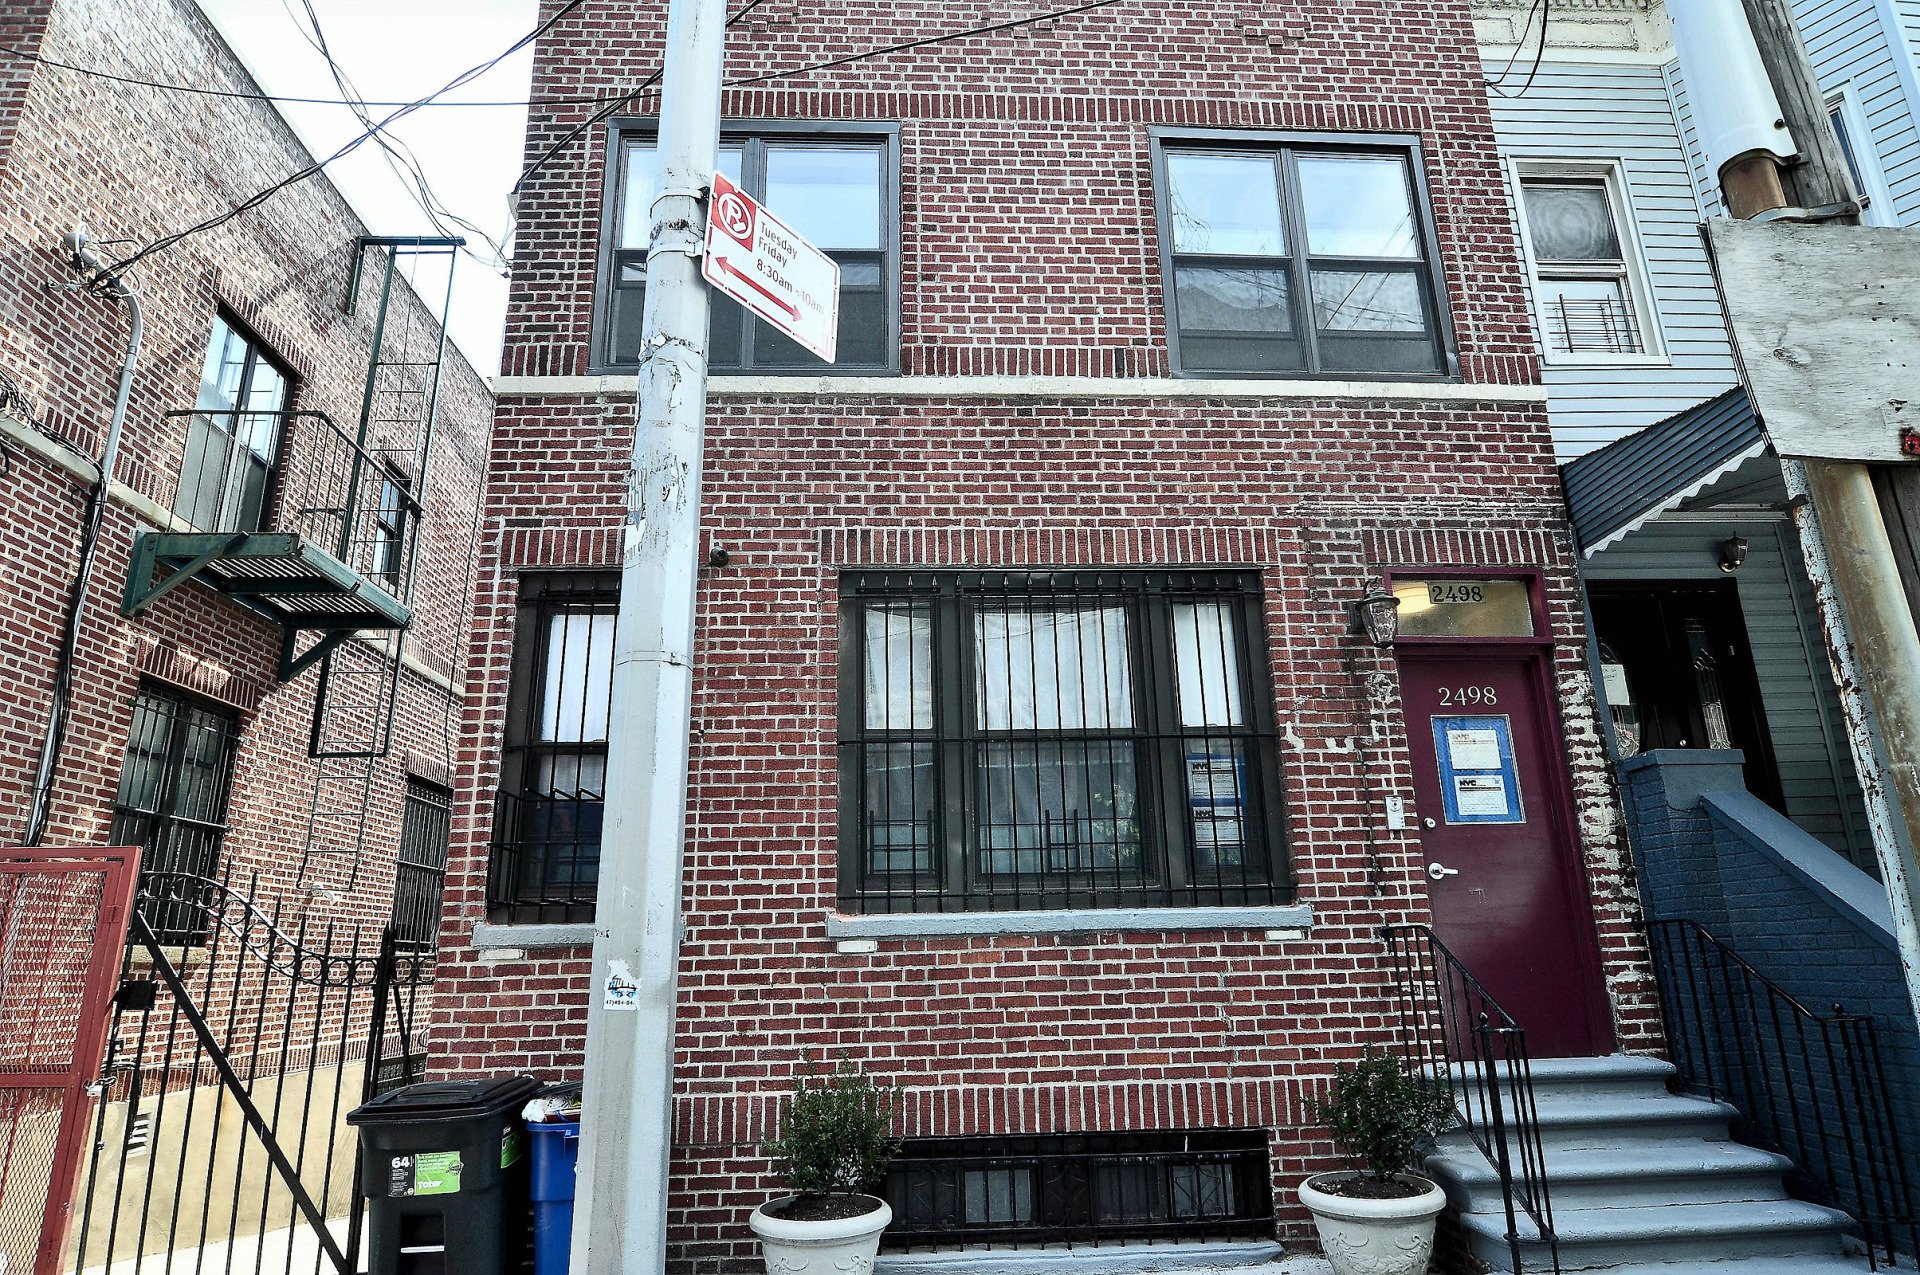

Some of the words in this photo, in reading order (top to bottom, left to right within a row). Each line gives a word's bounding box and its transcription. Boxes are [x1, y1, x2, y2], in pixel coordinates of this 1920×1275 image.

[758, 236, 788, 267] Friday
[761, 221, 798, 259] Tuesday
[756, 258, 793, 293] 8:30am
[801, 291, 825, 316] 10am
[1432, 585, 1484, 603] 2498
[1438, 686, 1498, 706] 2498
[391, 1156, 410, 1169] 64
